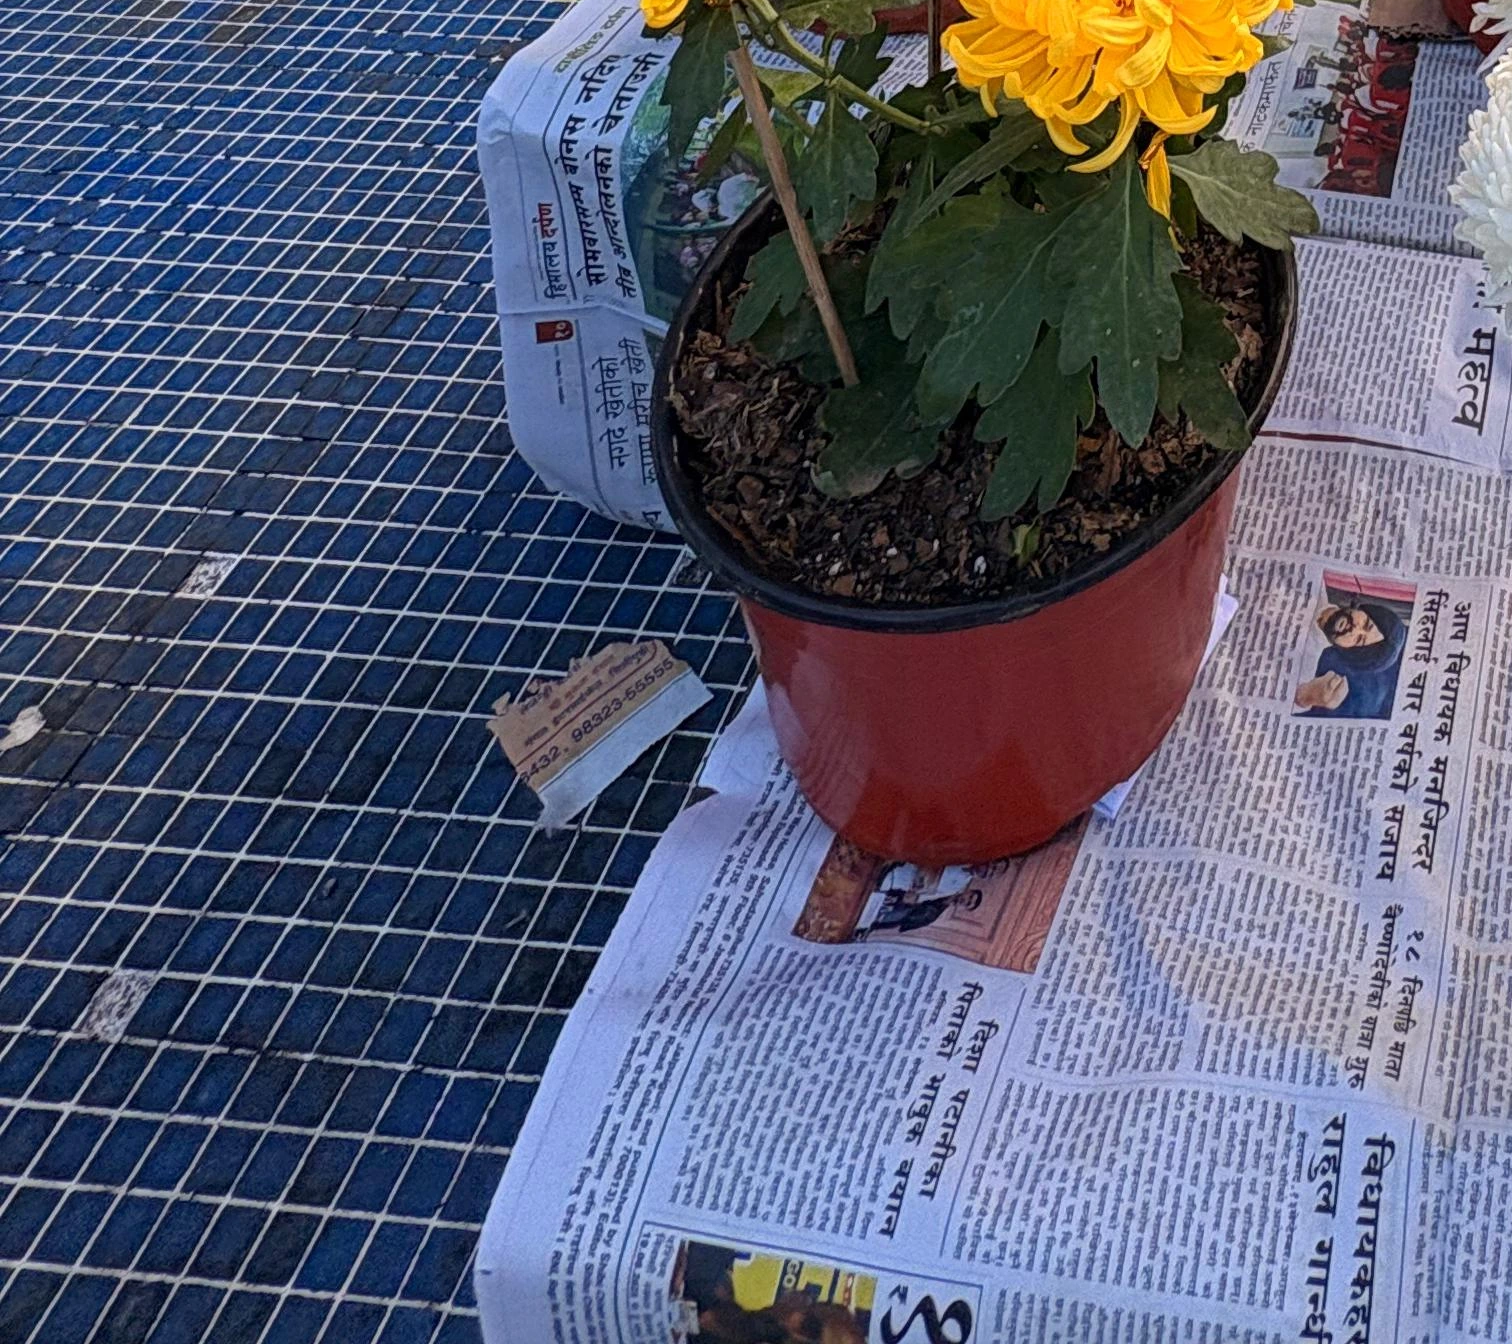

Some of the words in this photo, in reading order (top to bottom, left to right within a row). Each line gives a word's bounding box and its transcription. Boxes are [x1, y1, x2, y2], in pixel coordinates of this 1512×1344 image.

[542, 232, 568, 300] हिमालय
[596, 355, 632, 423] खेतीको
[1452, 326, 1497, 436] महत्व
[1411, 590, 1449, 663] सिंहलाई
[1450, 603, 1471, 642] आप
[1403, 672, 1427, 713] चार
[1435, 653, 1470, 744] विधायक
[1390, 724, 1422, 793] वर्षको
[1376, 805, 1405, 881] सजाय
[1413, 757, 1449, 873] मनजिन्दर
[744, 874, 758, 892] 9th
[726, 895, 749, 930] Floor,
[1406, 931, 1424, 961] १८
[937, 982, 983, 1060] पिताको
[1357, 1016, 1377, 1050] यात्रा
[1394, 977, 1423, 1033] दिनपछि
[653, 1035, 676, 1073] Road,
[962, 1021, 999, 1073] दिशा
[1384, 1041, 1405, 1081] माता
[630, 1079, 658, 1131] Kolkata
[638, 1118, 653, 1146] and
[906, 1074, 945, 1145] भावुक
[920, 1090, 969, 1199] पटानीका
[1308, 1114, 1346, 1217] राहुल
[606, 1150, 641, 1224] published
[588, 1213, 609, 1258] Editor
[603, 1229, 617, 1247] by
